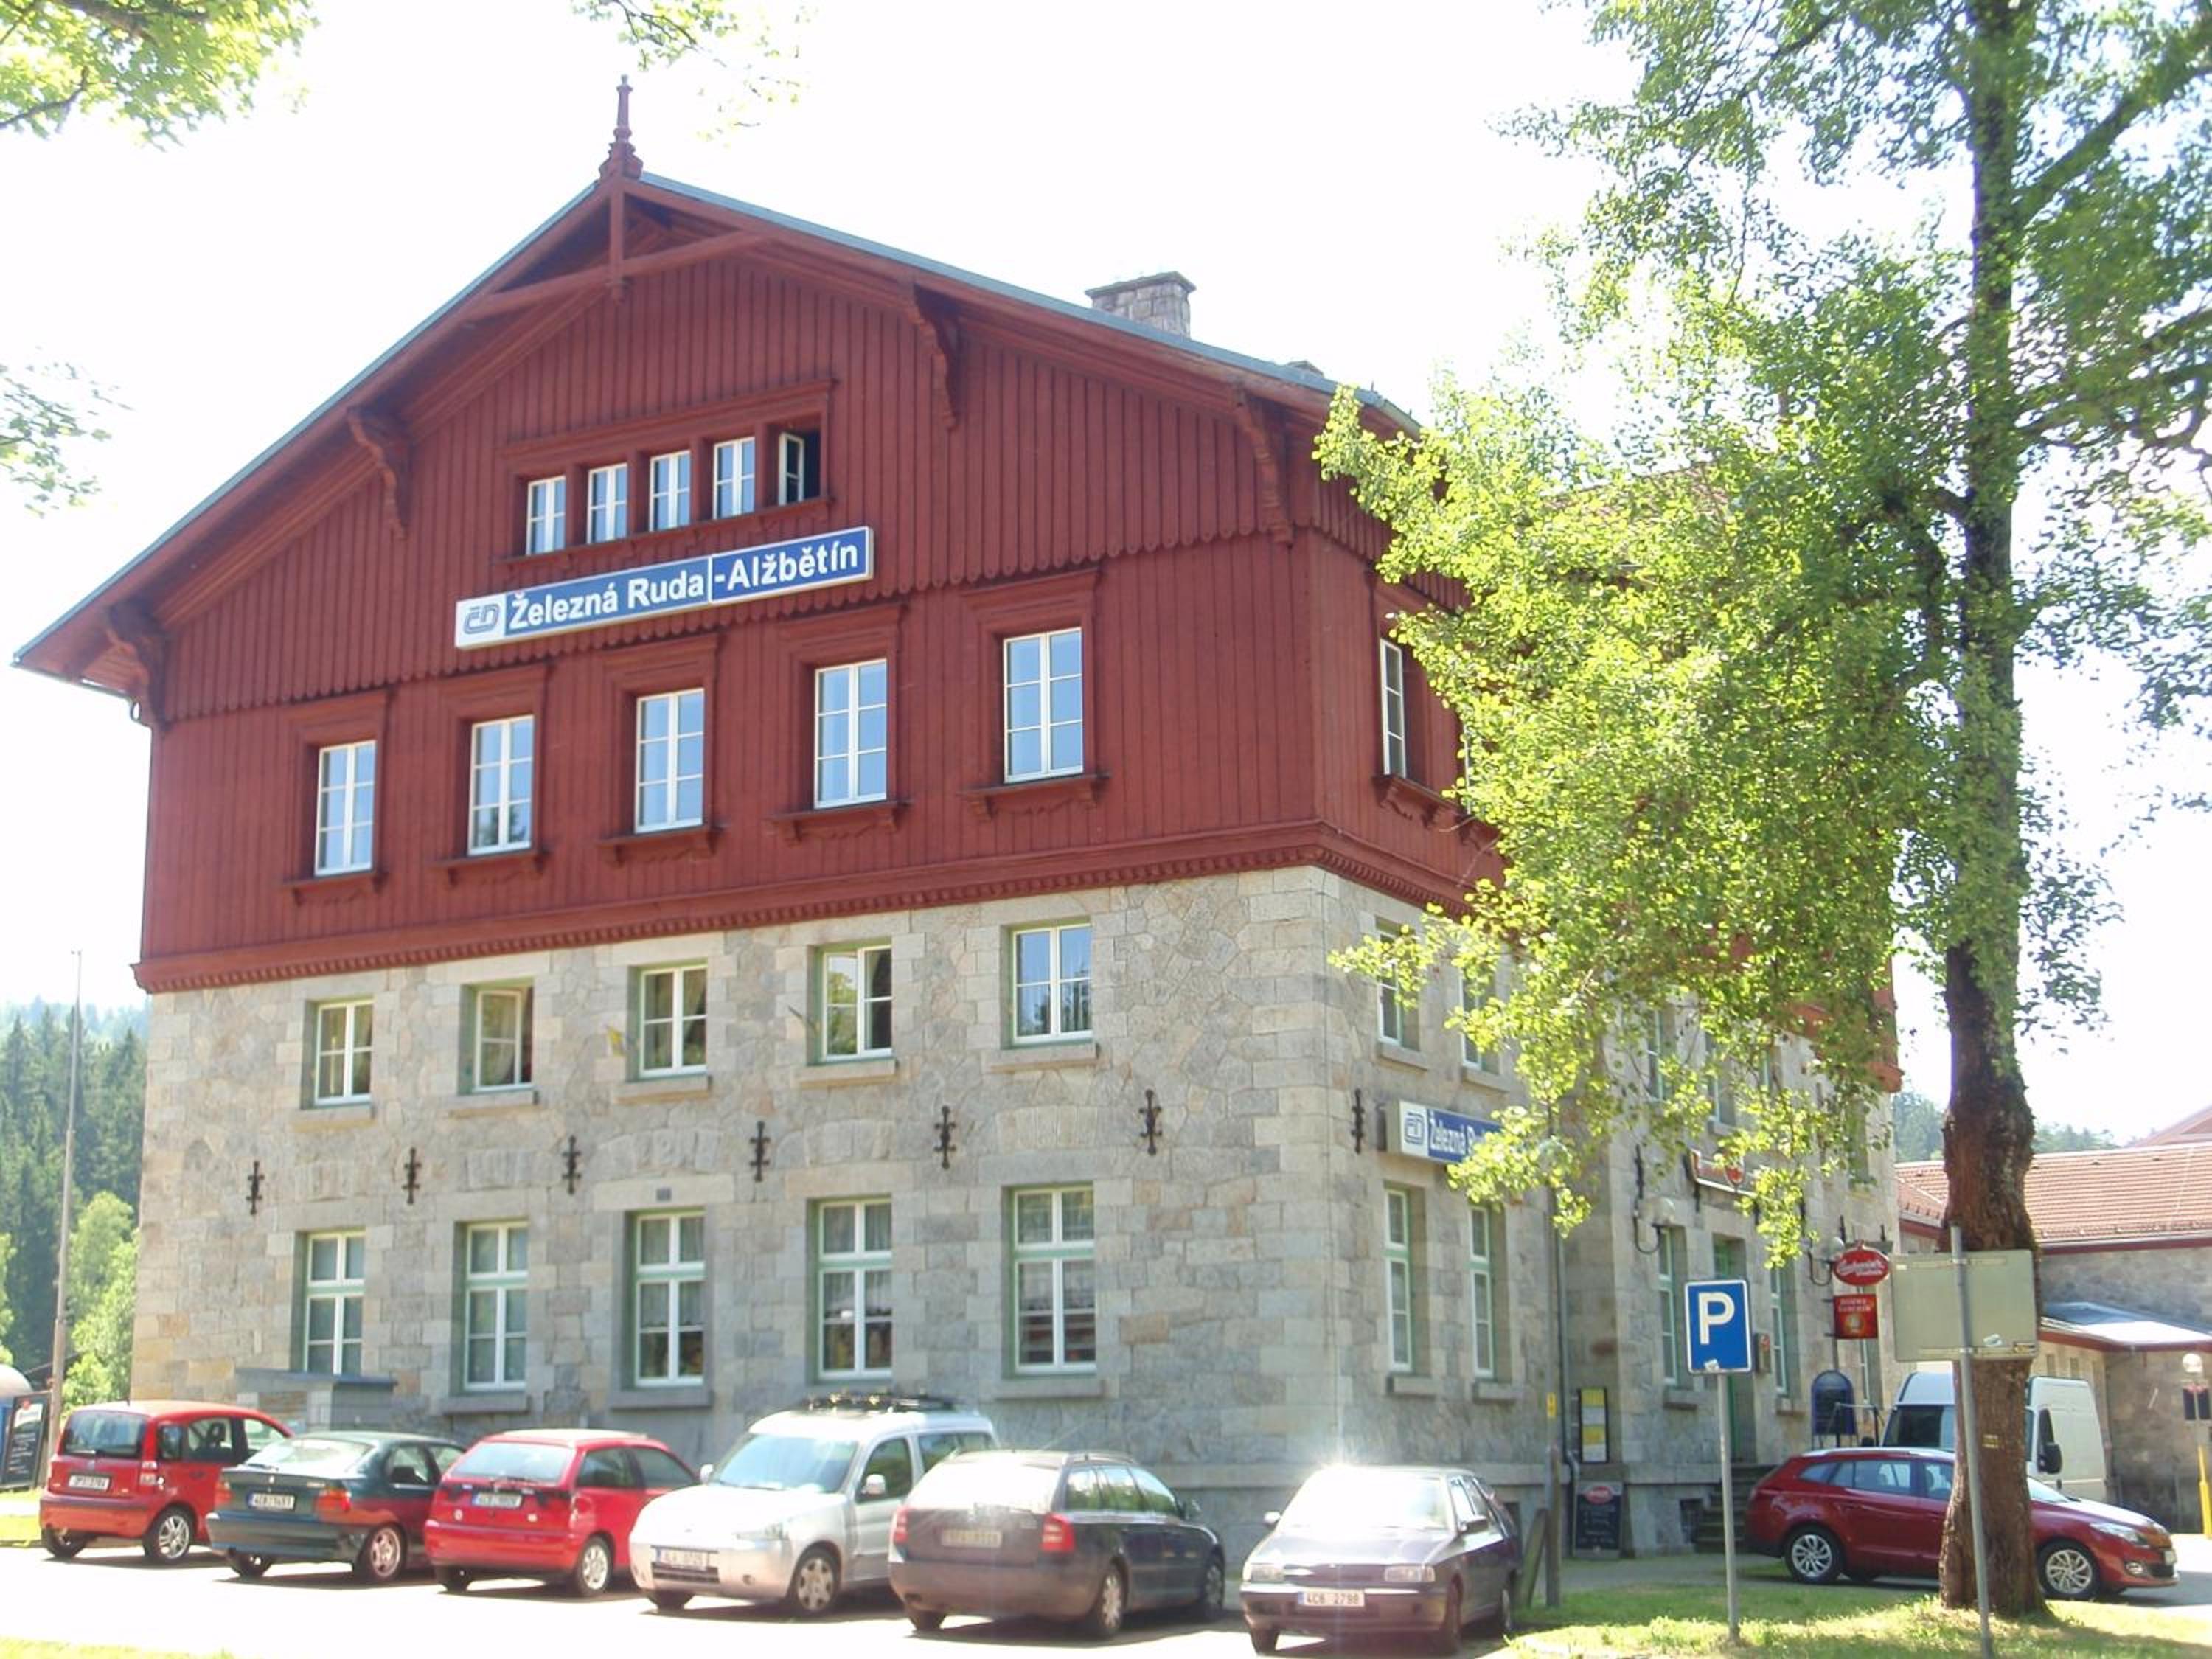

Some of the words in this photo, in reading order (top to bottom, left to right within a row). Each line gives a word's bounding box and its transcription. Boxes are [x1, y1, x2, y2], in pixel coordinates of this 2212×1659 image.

[509, 582, 619, 629] Železná
[627, 570, 704, 608] Ruda
[1698, 1292, 1735, 1345] P
